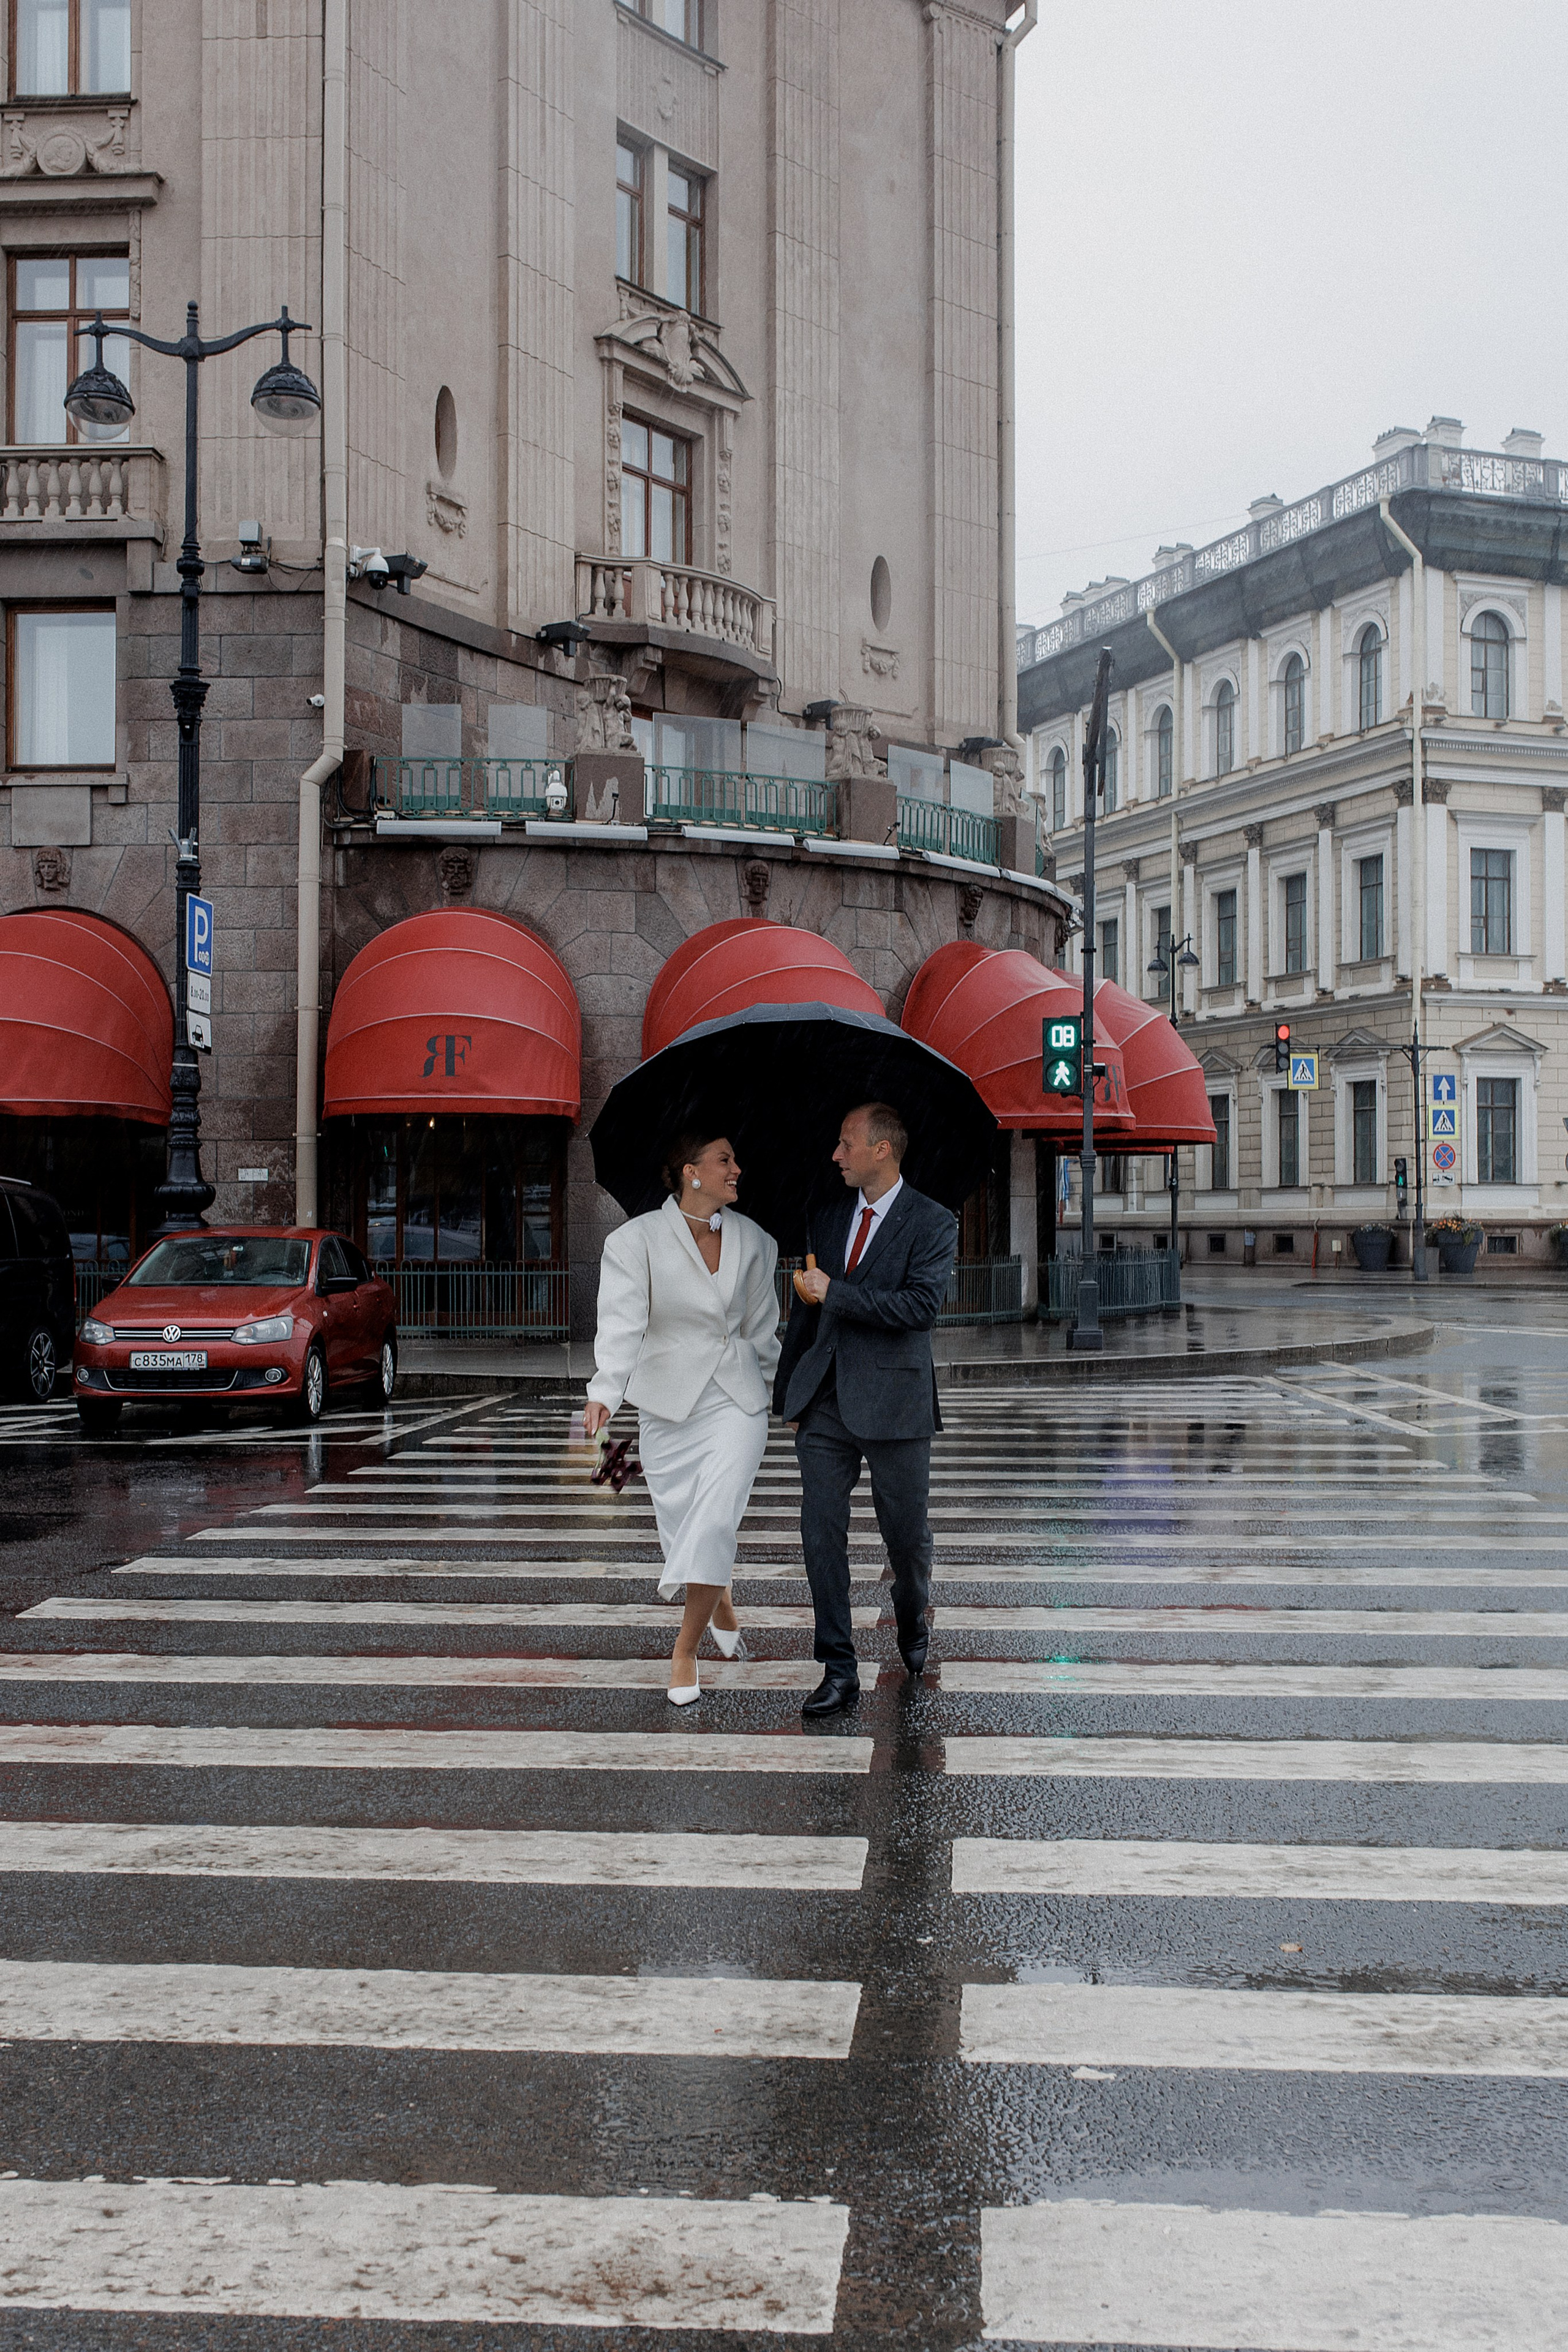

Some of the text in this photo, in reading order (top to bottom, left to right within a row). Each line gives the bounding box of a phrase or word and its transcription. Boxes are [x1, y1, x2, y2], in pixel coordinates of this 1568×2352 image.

[194, 906, 208, 963] P
[1052, 1025, 1075, 1047] 08
[185, 1353, 203, 1363] 178
